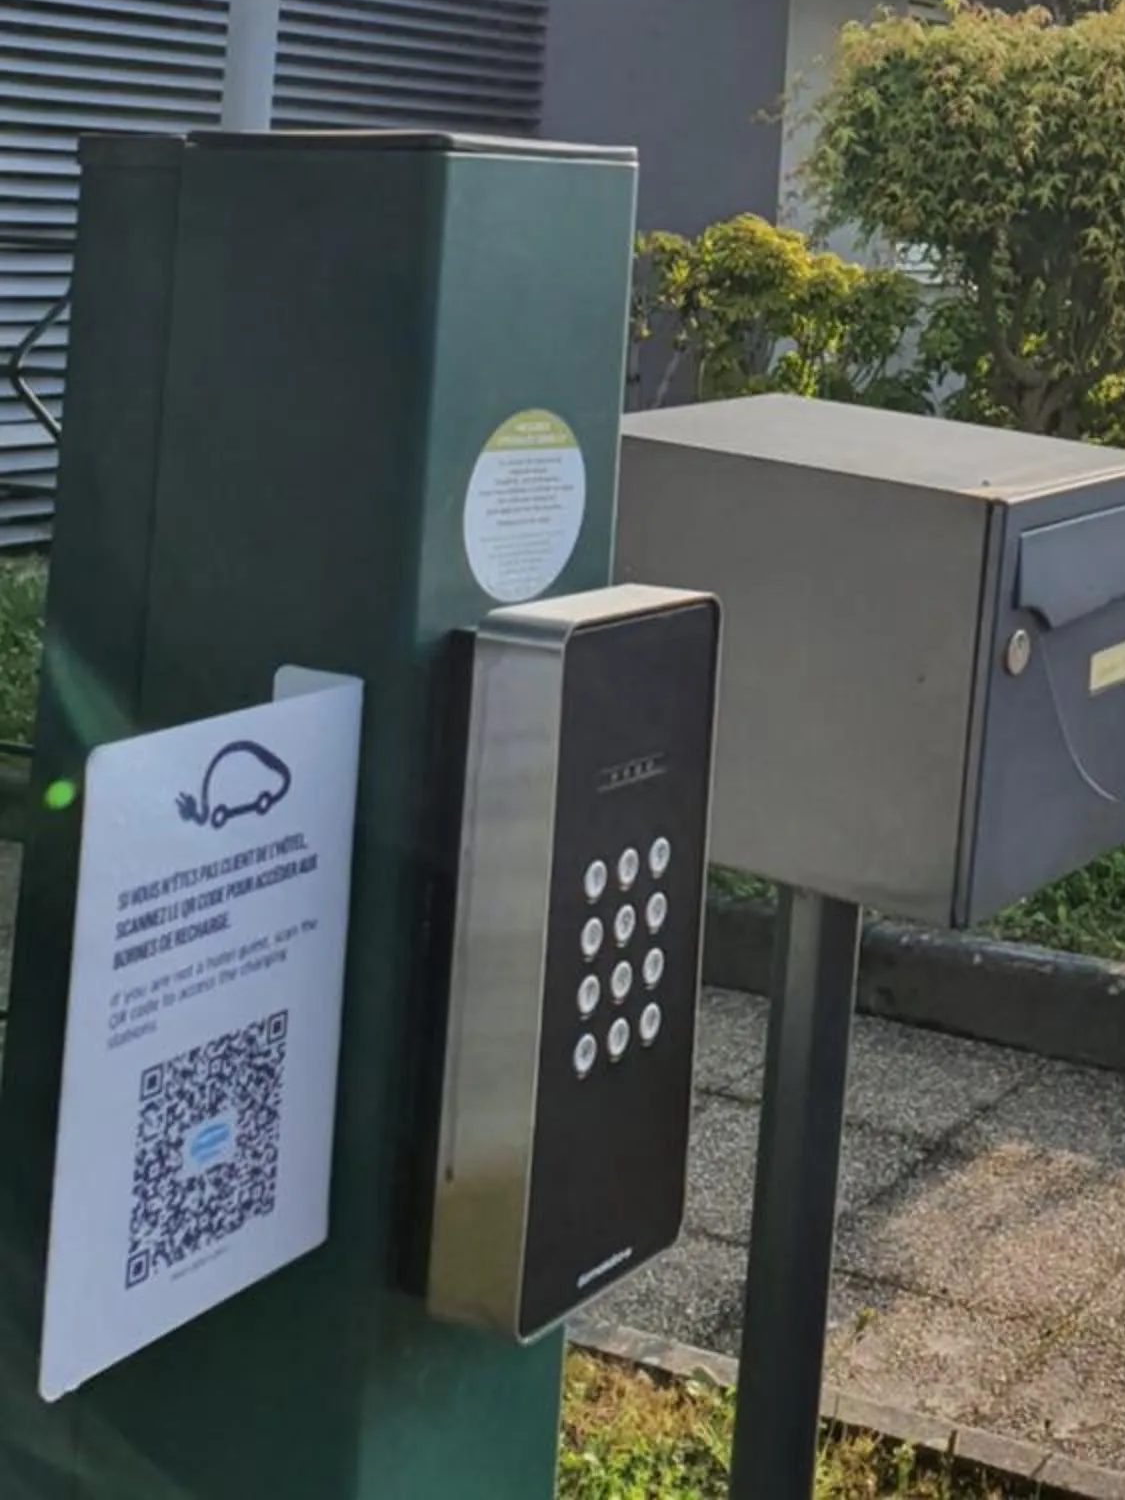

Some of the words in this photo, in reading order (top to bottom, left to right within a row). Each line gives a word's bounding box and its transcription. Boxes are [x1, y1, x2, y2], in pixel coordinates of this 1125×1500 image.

[115, 906, 167, 940] SCANNEZ
[168, 902, 179, 922] LE
[181, 896, 196, 919] QR
[198, 886, 224, 911] CODE
[225, 876, 255, 900] POUR
[299, 852, 318, 874] AUX
[131, 880, 160, 906] VOUS
[199, 861, 219, 882] PAS
[220, 847, 255, 875] CLIENT
[113, 937, 158, 970] BORNES
[159, 931, 173, 953] DE
[124, 984, 148, 1006] you
[150, 976, 170, 993] are
[301, 918, 318, 933] the
[108, 1009, 128, 1031] QR
[129, 999, 160, 1021] code
